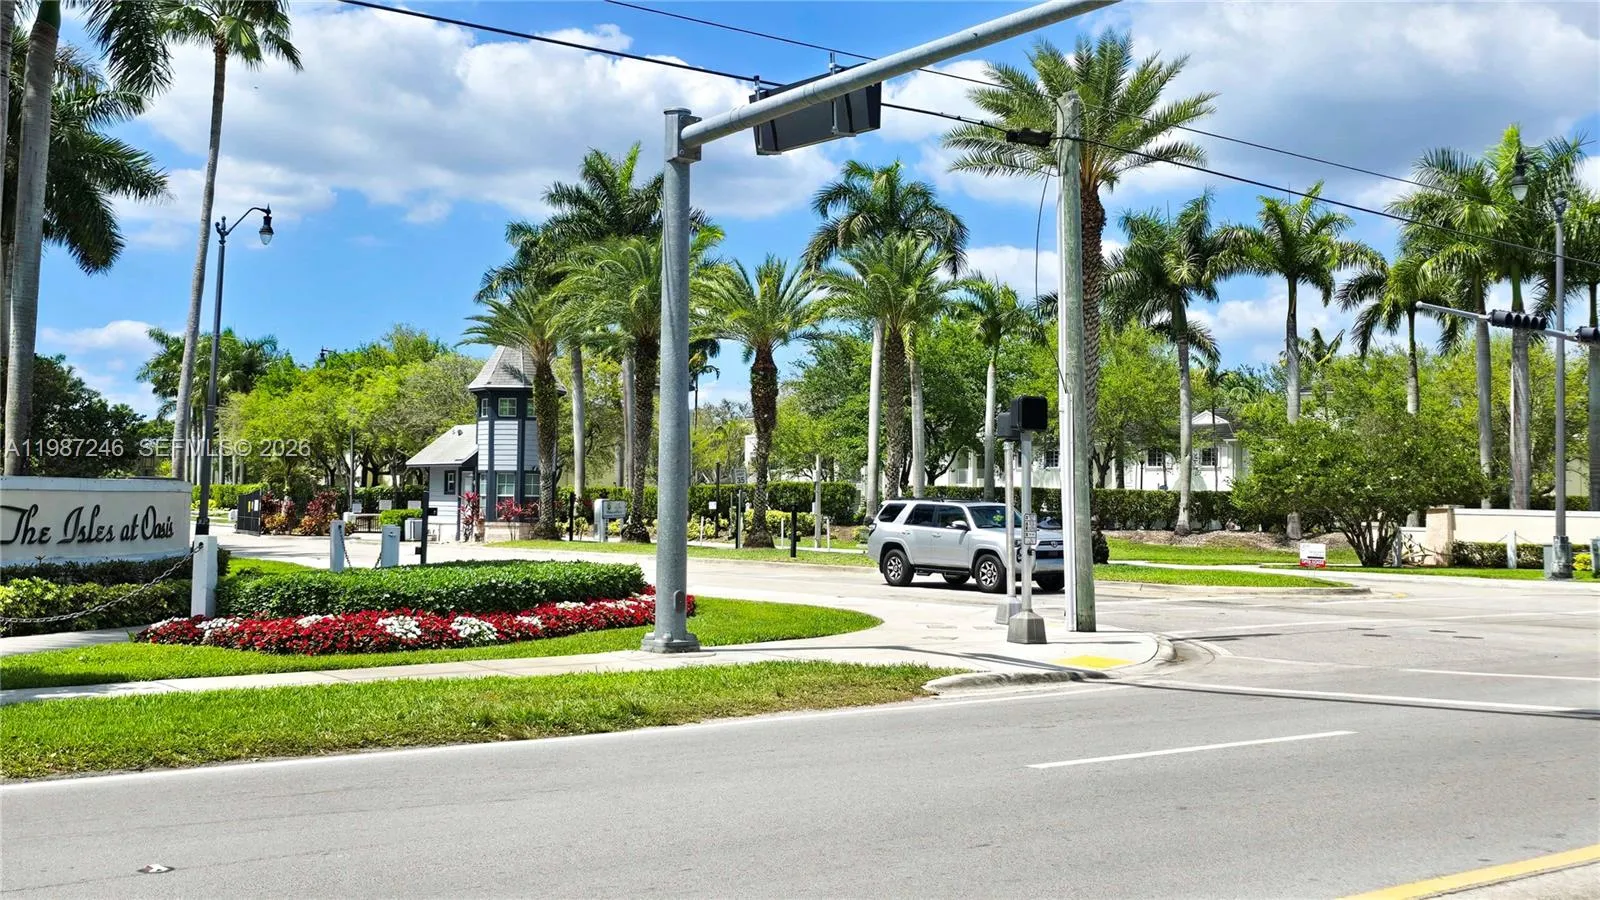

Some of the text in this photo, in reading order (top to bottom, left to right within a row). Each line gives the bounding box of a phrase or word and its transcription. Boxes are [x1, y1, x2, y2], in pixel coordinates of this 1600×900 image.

[0, 504, 174, 545] The Isles at Oasis
